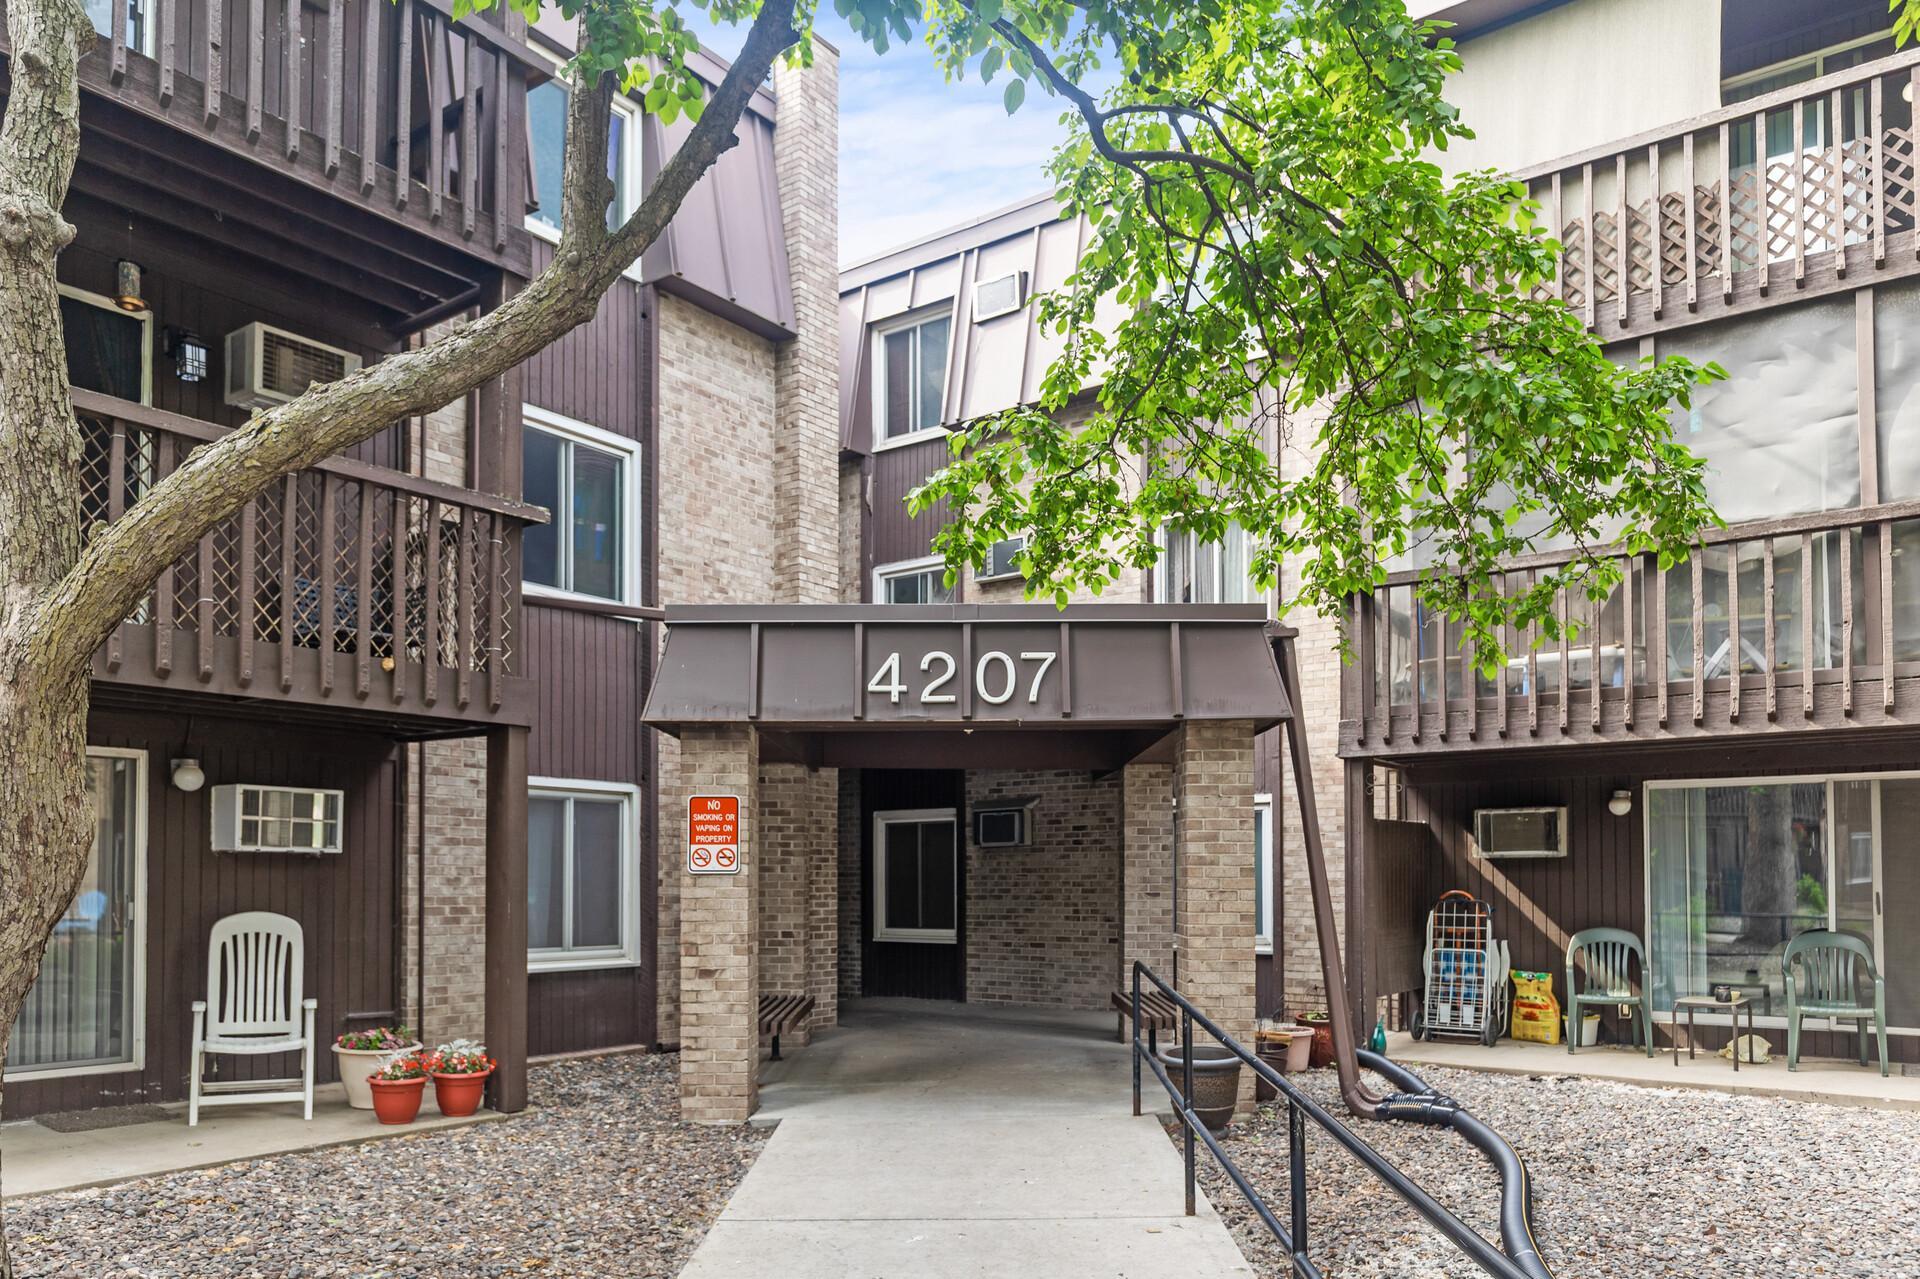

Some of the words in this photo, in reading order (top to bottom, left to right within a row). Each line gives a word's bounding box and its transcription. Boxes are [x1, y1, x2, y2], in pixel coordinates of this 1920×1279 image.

[867, 651, 1057, 704] 4207
[707, 800, 721, 811] NO
[693, 813, 723, 821] SMOKING
[725, 813, 735, 821] OR
[695, 824, 720, 832] VAPING
[722, 824, 733, 832] ON
[695, 835, 732, 843] PROPERTY
